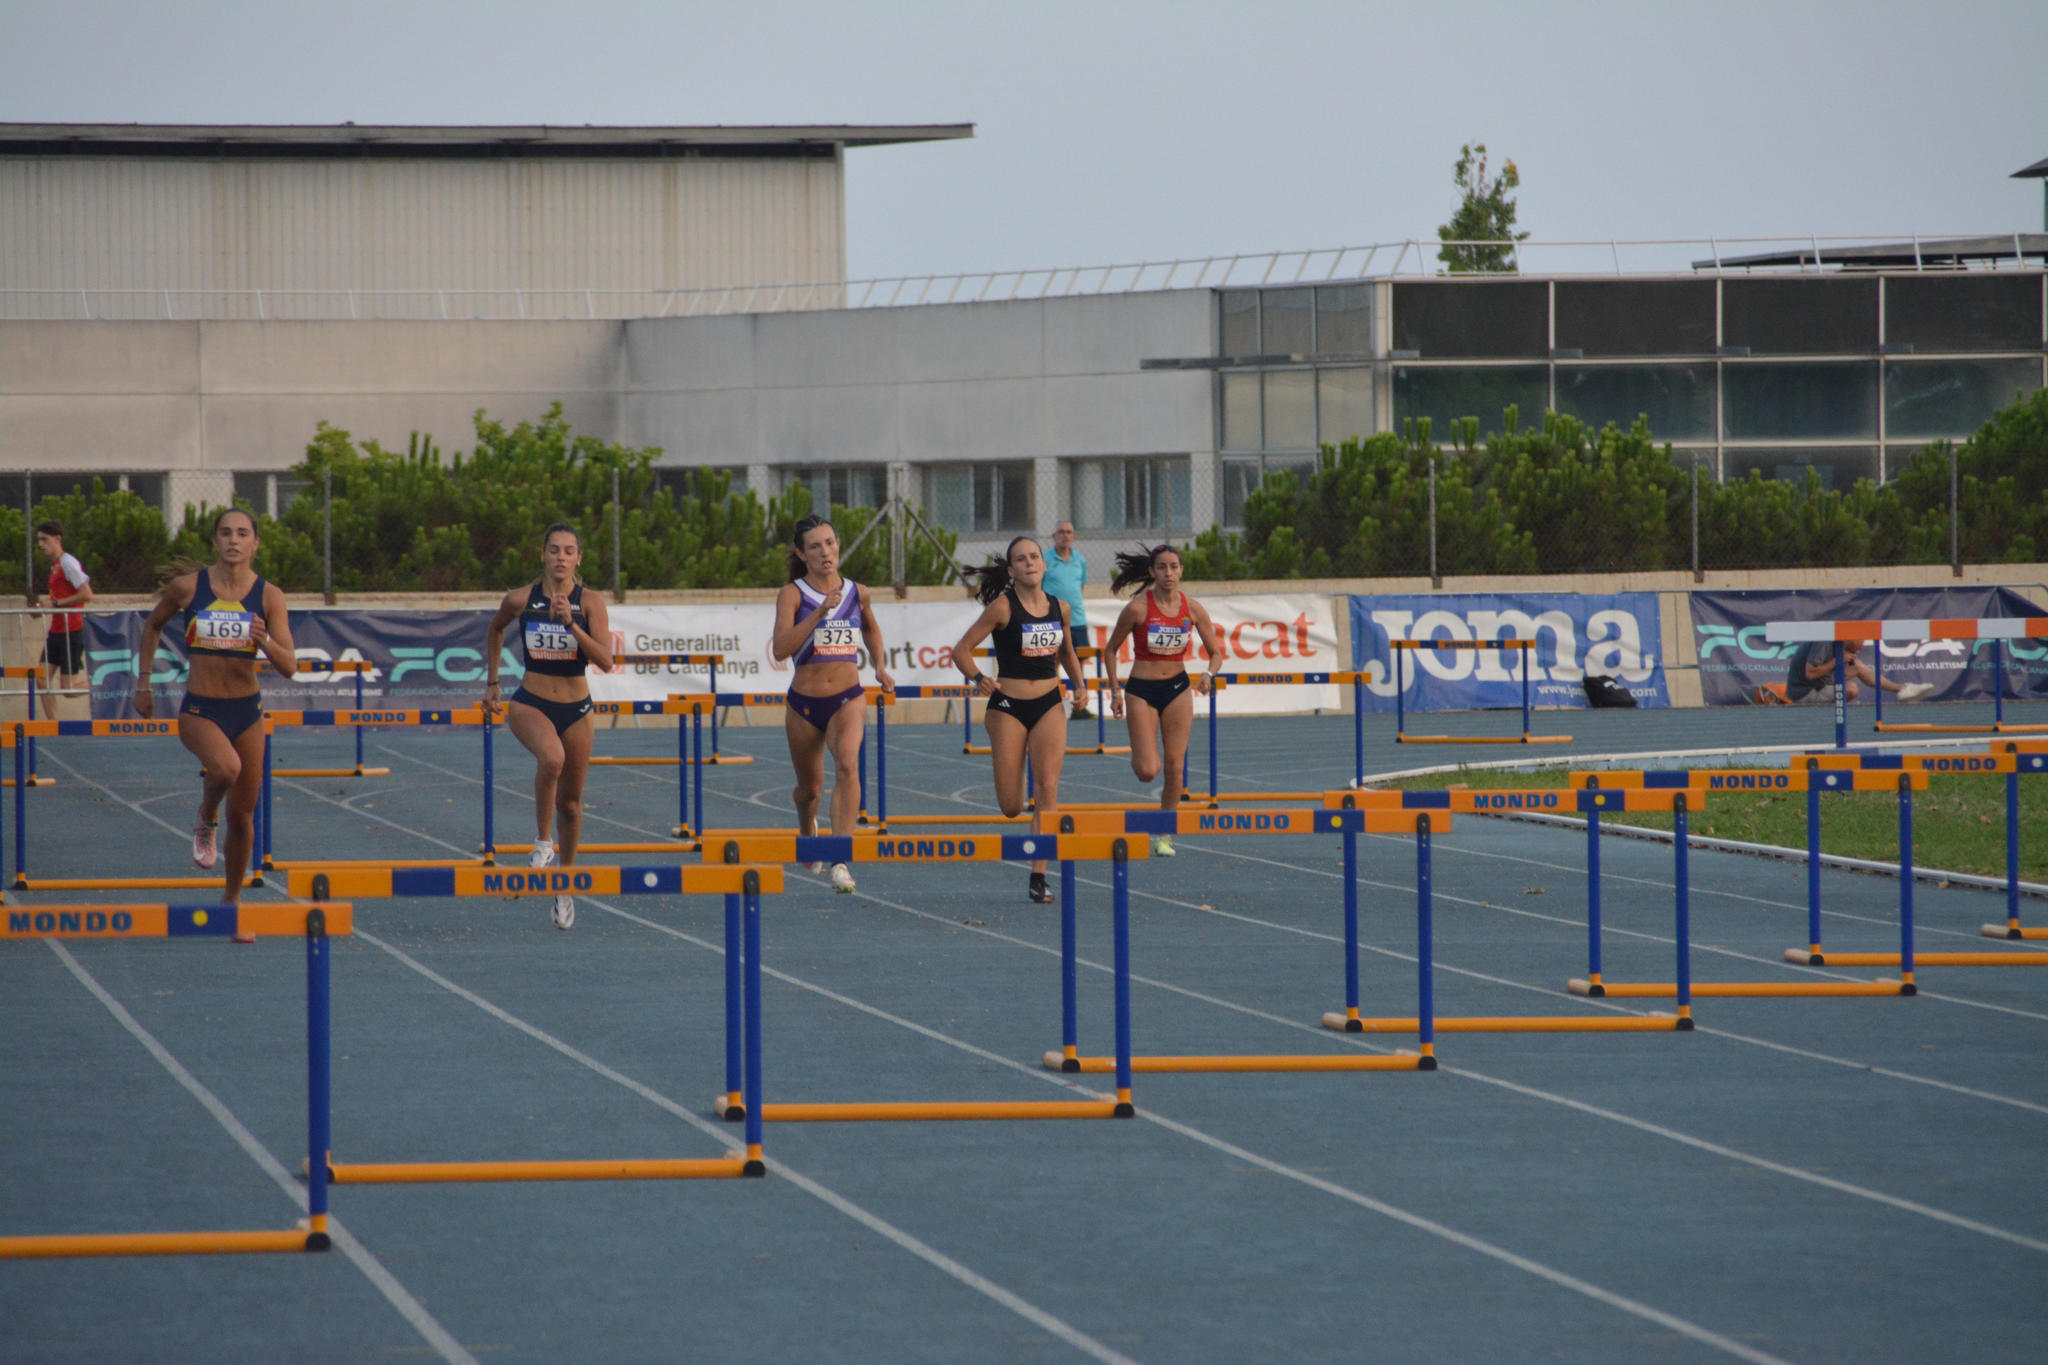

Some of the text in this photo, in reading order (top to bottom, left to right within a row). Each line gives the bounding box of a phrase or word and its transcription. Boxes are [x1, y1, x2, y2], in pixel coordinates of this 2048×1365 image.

[206, 621, 243, 638] 169
[823, 629, 853, 645] 373
[534, 633, 568, 650] 315
[635, 634, 740, 652] Generalitat
[1030, 631, 1057, 647] 462
[1155, 634, 1181, 647] 475
[1697, 624, 1799, 660] FC
[667, 659, 759, 679] Cataunya
[1883, 662, 1924, 672] CATALANA
[1926, 661, 1968, 669] ATLETISME
[1248, 675, 1293, 683] MONDO
[753, 695, 785, 705] MON
[932, 687, 981, 697] MONDO
[1835, 683, 1845, 724] MONDO
[350, 711, 407, 722] MONDO
[109, 723, 169, 733] MONDO
[1922, 757, 1997, 771] MONDO
[1710, 775, 1789, 789] MONDO
[1474, 793, 1558, 809] MONDO
[1199, 814, 1290, 830] MONDO
[877, 840, 976, 857] MONDO
[483, 872, 593, 892] MONDO
[8, 912, 133, 933] MONDO
